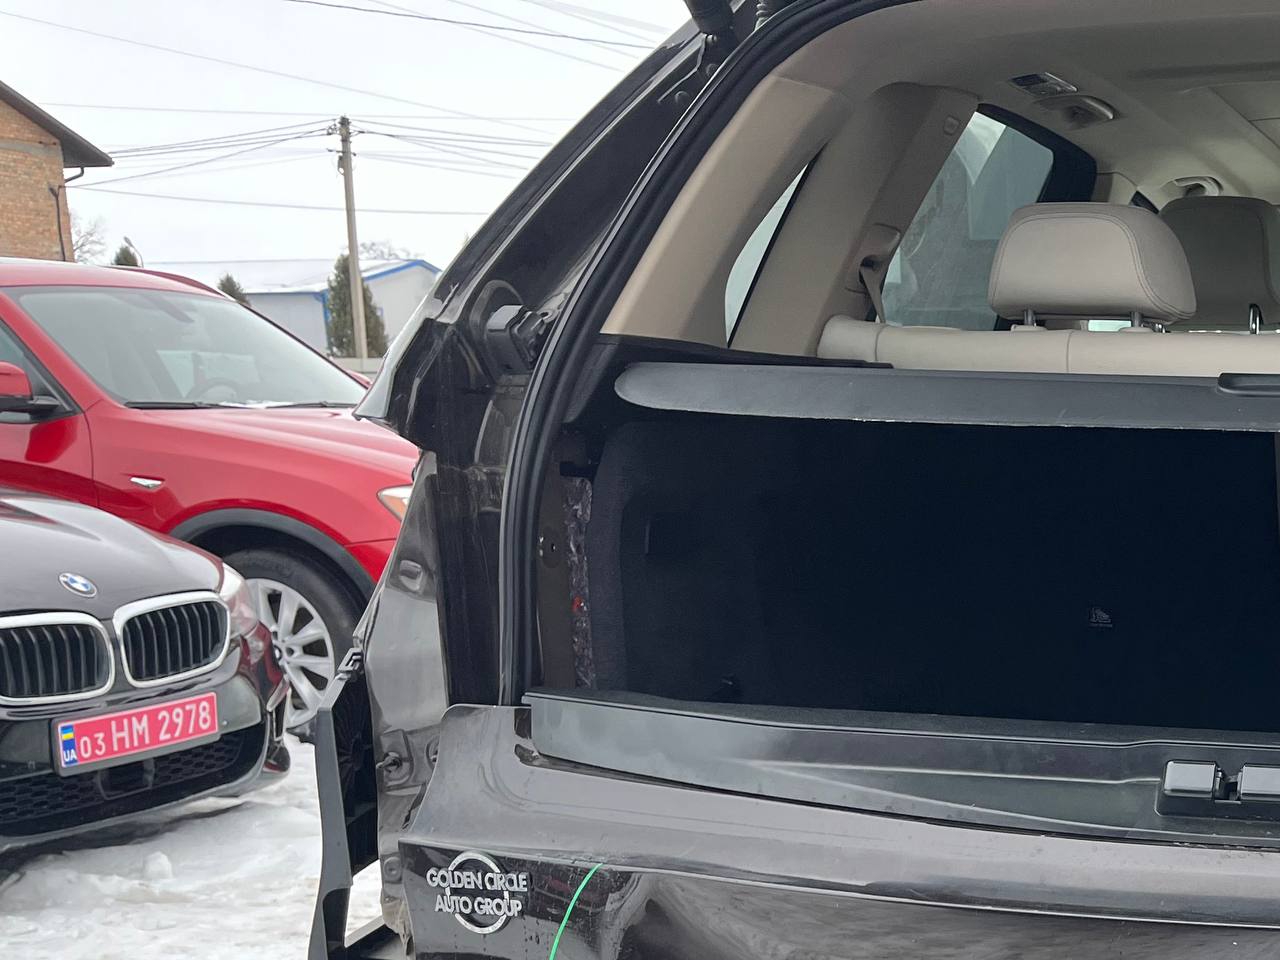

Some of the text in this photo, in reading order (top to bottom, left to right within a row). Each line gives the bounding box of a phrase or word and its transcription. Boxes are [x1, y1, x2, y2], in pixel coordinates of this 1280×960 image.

[79, 701, 212, 758] 03 HM 2978
[63, 748, 78, 762] UA
[426, 868, 528, 892] GOLDEN CIRCLE
[434, 894, 523, 917] AUTO GROUP
